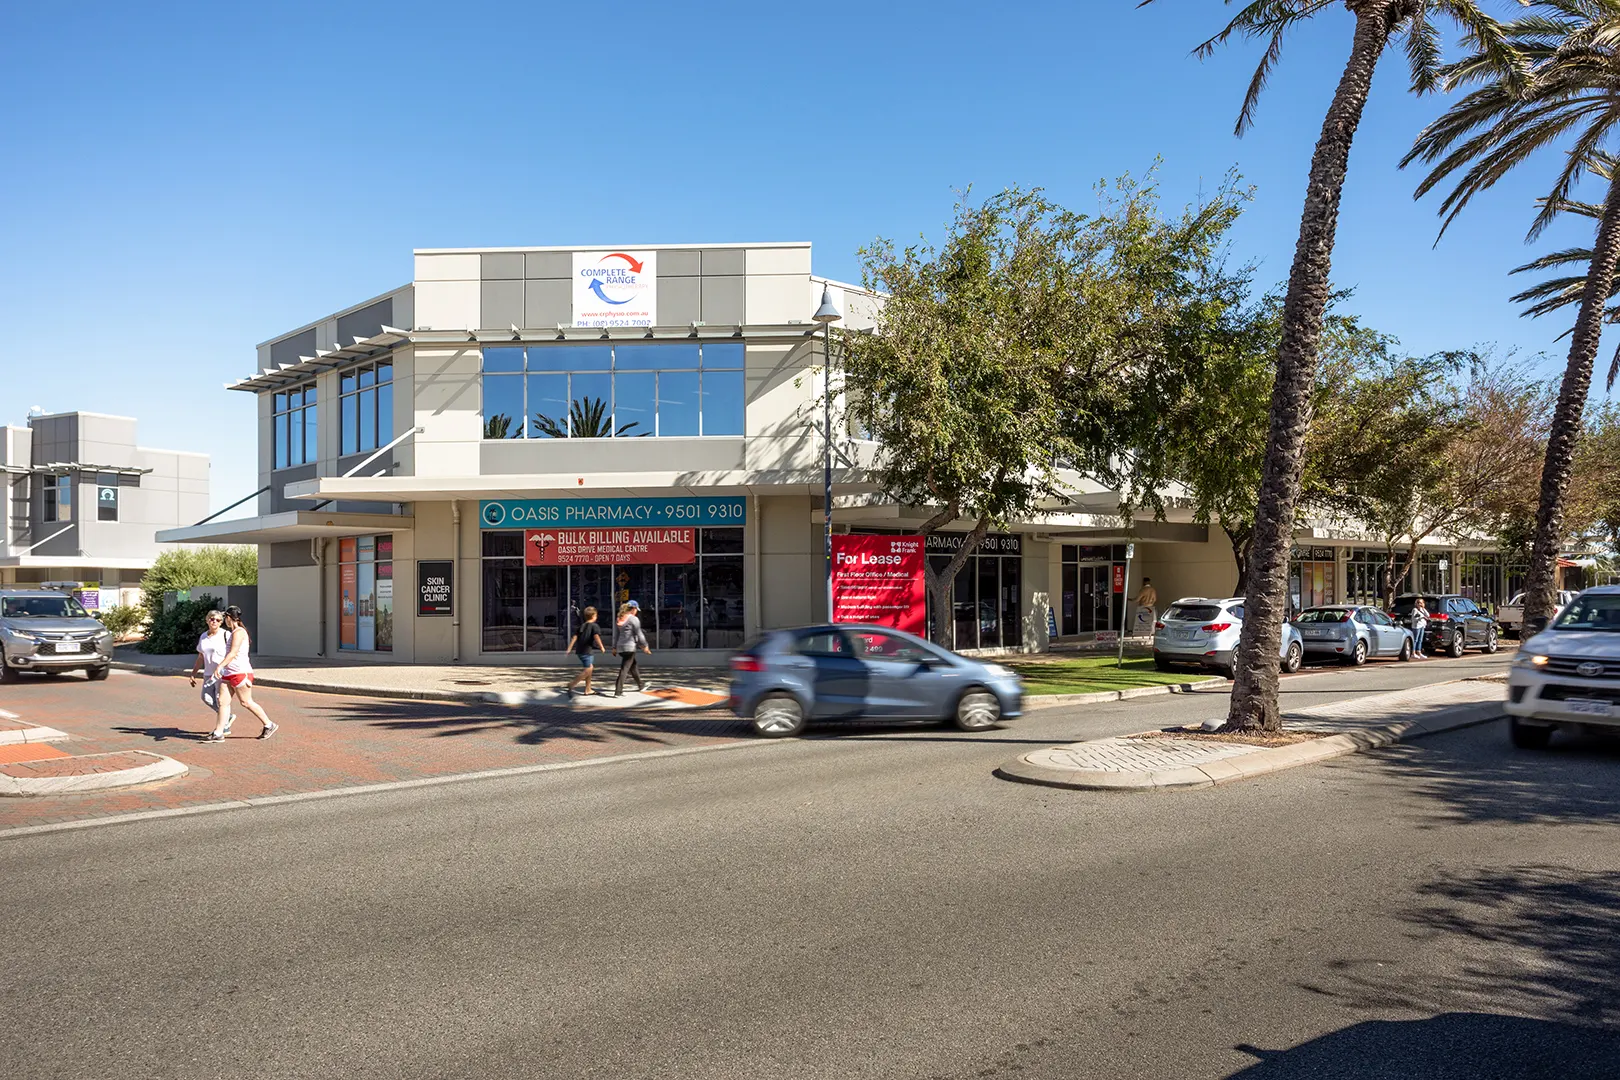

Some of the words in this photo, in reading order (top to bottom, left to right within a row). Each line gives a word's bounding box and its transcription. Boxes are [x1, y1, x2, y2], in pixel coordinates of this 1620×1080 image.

[580, 268, 626, 277] COMPLETE
[606, 276, 636, 284] RANGE
[511, 506, 560, 520] OASIS
[565, 505, 653, 520] PHARMACY
[664, 505, 701, 519] 9501
[707, 504, 743, 518] 9310
[557, 532, 586, 544] BULK
[589, 531, 630, 544] BILLING
[633, 530, 690, 543] AVAILABLE
[577, 545, 596, 553] DRIVE
[597, 545, 623, 553] MEDICAL
[624, 544, 649, 553] CENTRE
[1000, 539, 1019, 550] 9310
[557, 555, 574, 563] 9524
[594, 554, 610, 562] OPEN
[615, 554, 631, 562] DAYS
[836, 552, 859, 565] For
[861, 552, 902, 565] Lease
[426, 577, 445, 585] SKIN
[421, 585, 450, 593] CANCER
[423, 593, 448, 602] CLINIC
